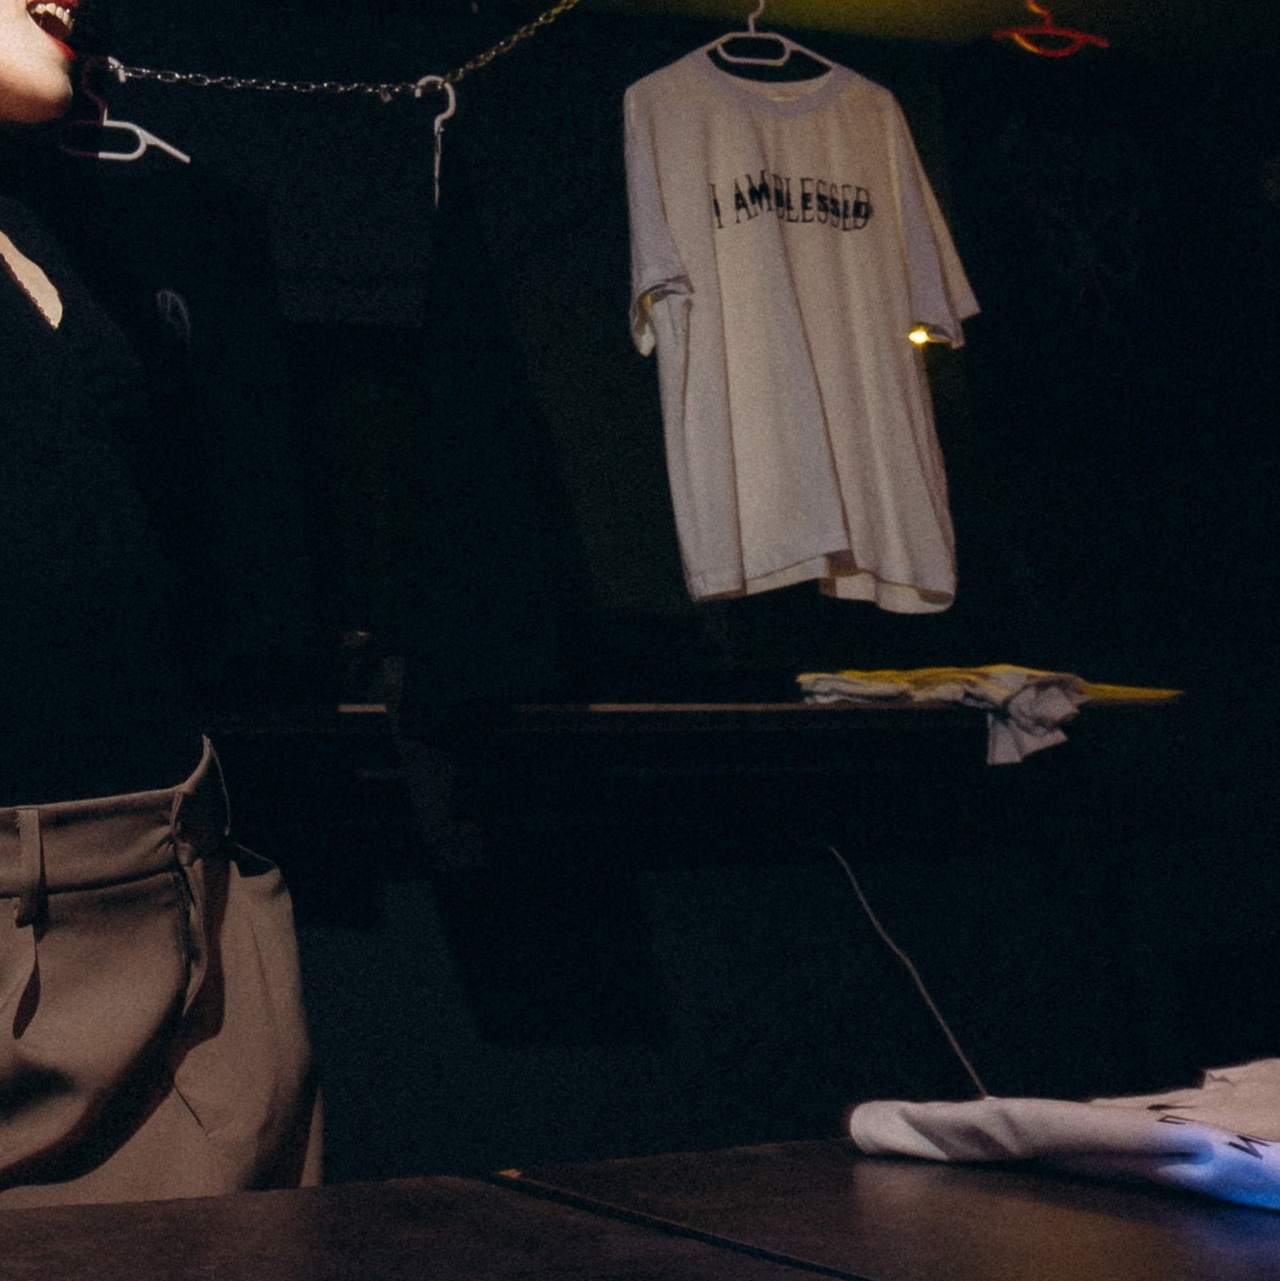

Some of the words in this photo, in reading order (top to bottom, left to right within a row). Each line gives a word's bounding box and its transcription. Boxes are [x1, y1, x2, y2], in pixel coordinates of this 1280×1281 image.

[710, 184, 724, 229] I
[733, 169, 773, 224] AM
[772, 174, 874, 232] BLESSED
